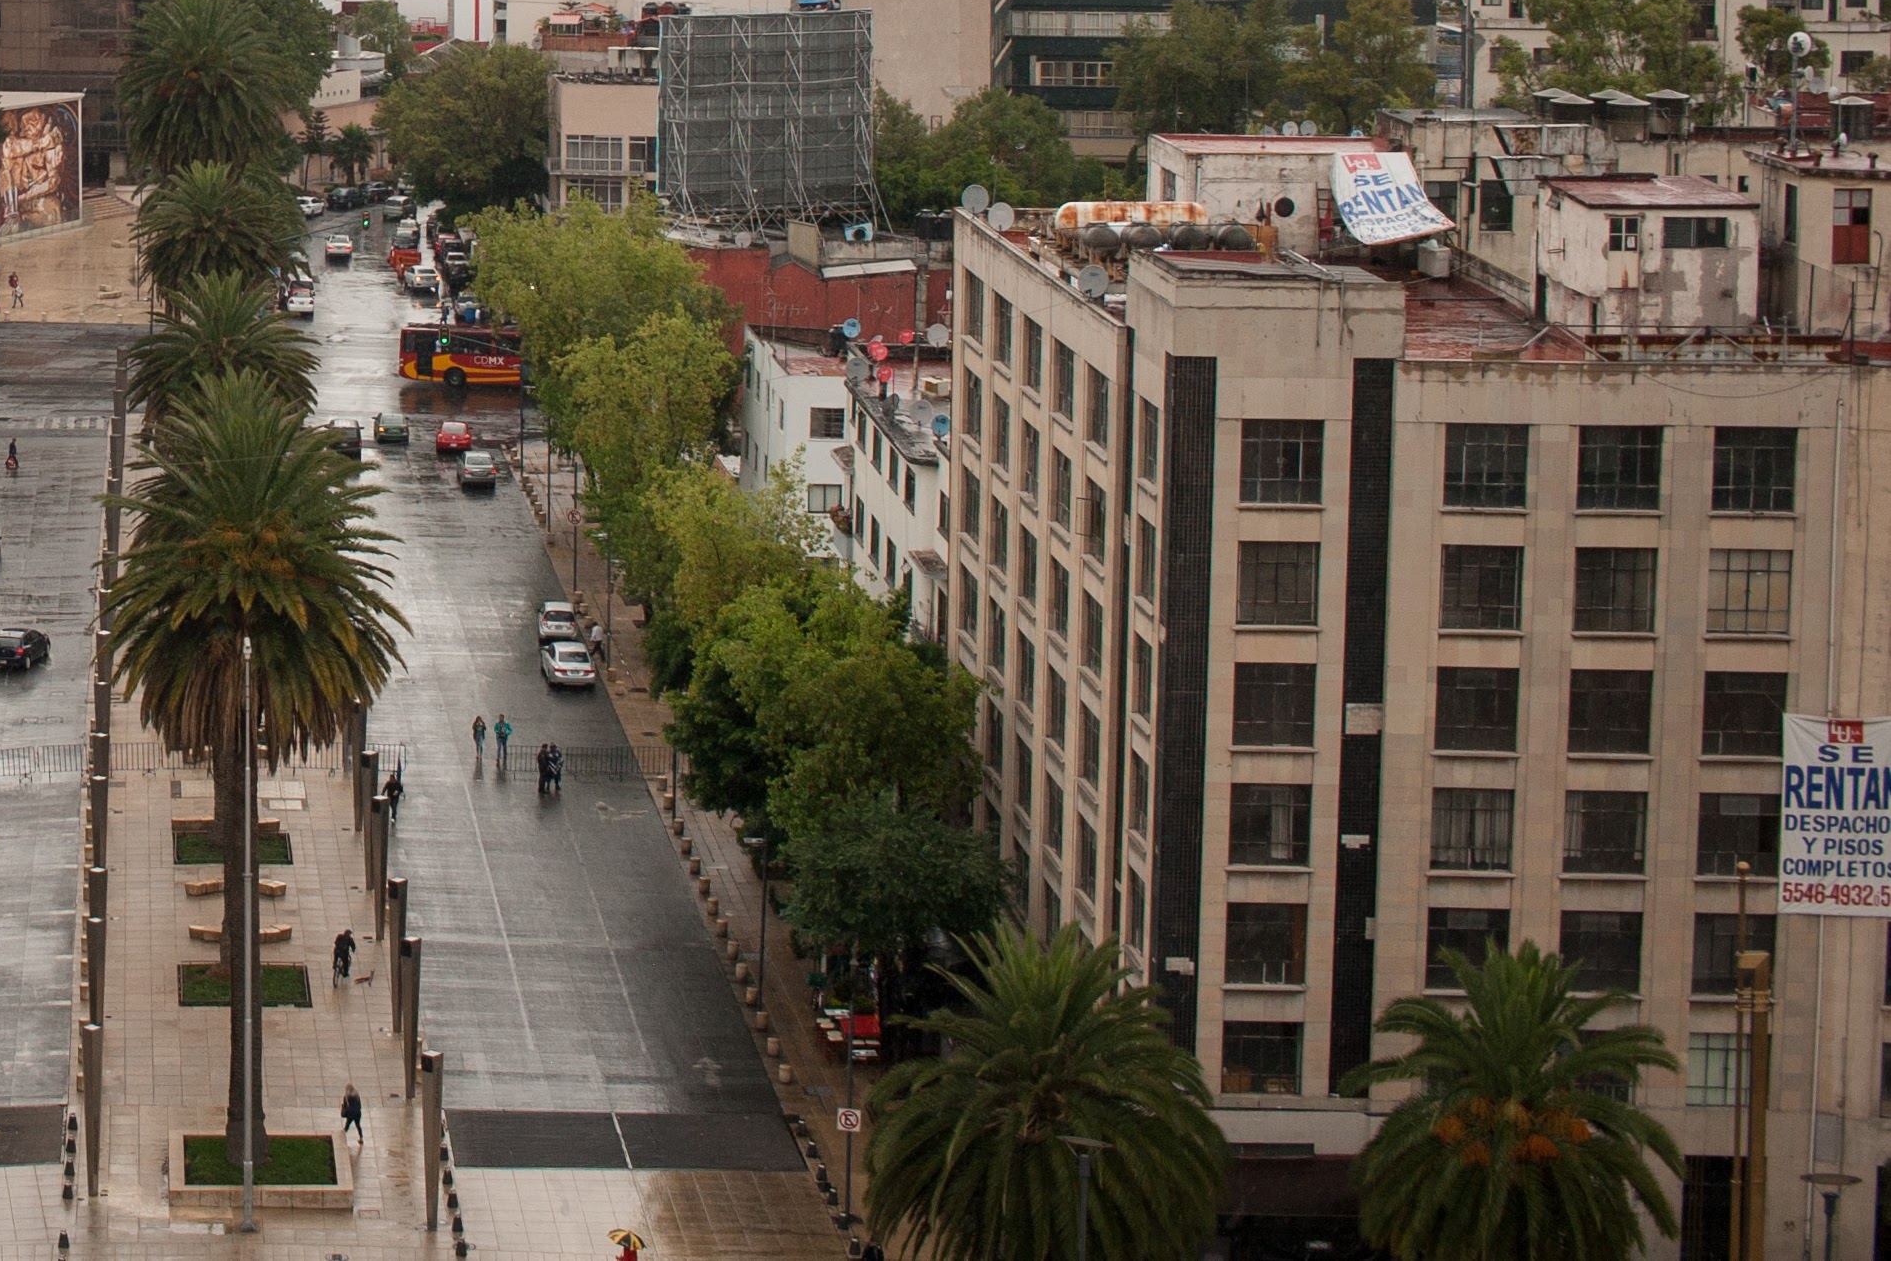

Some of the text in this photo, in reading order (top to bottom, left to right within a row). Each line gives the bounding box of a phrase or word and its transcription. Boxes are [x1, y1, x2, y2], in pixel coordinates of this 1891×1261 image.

[1354, 173, 1393, 187] SE
[1339, 181, 1425, 223] RENTAN
[473, 356, 505, 365] CDMX
[1818, 745, 1873, 763] SE
[1802, 837, 1884, 856] Y PISOS
[1782, 882, 1873, 906] 5546-4932
